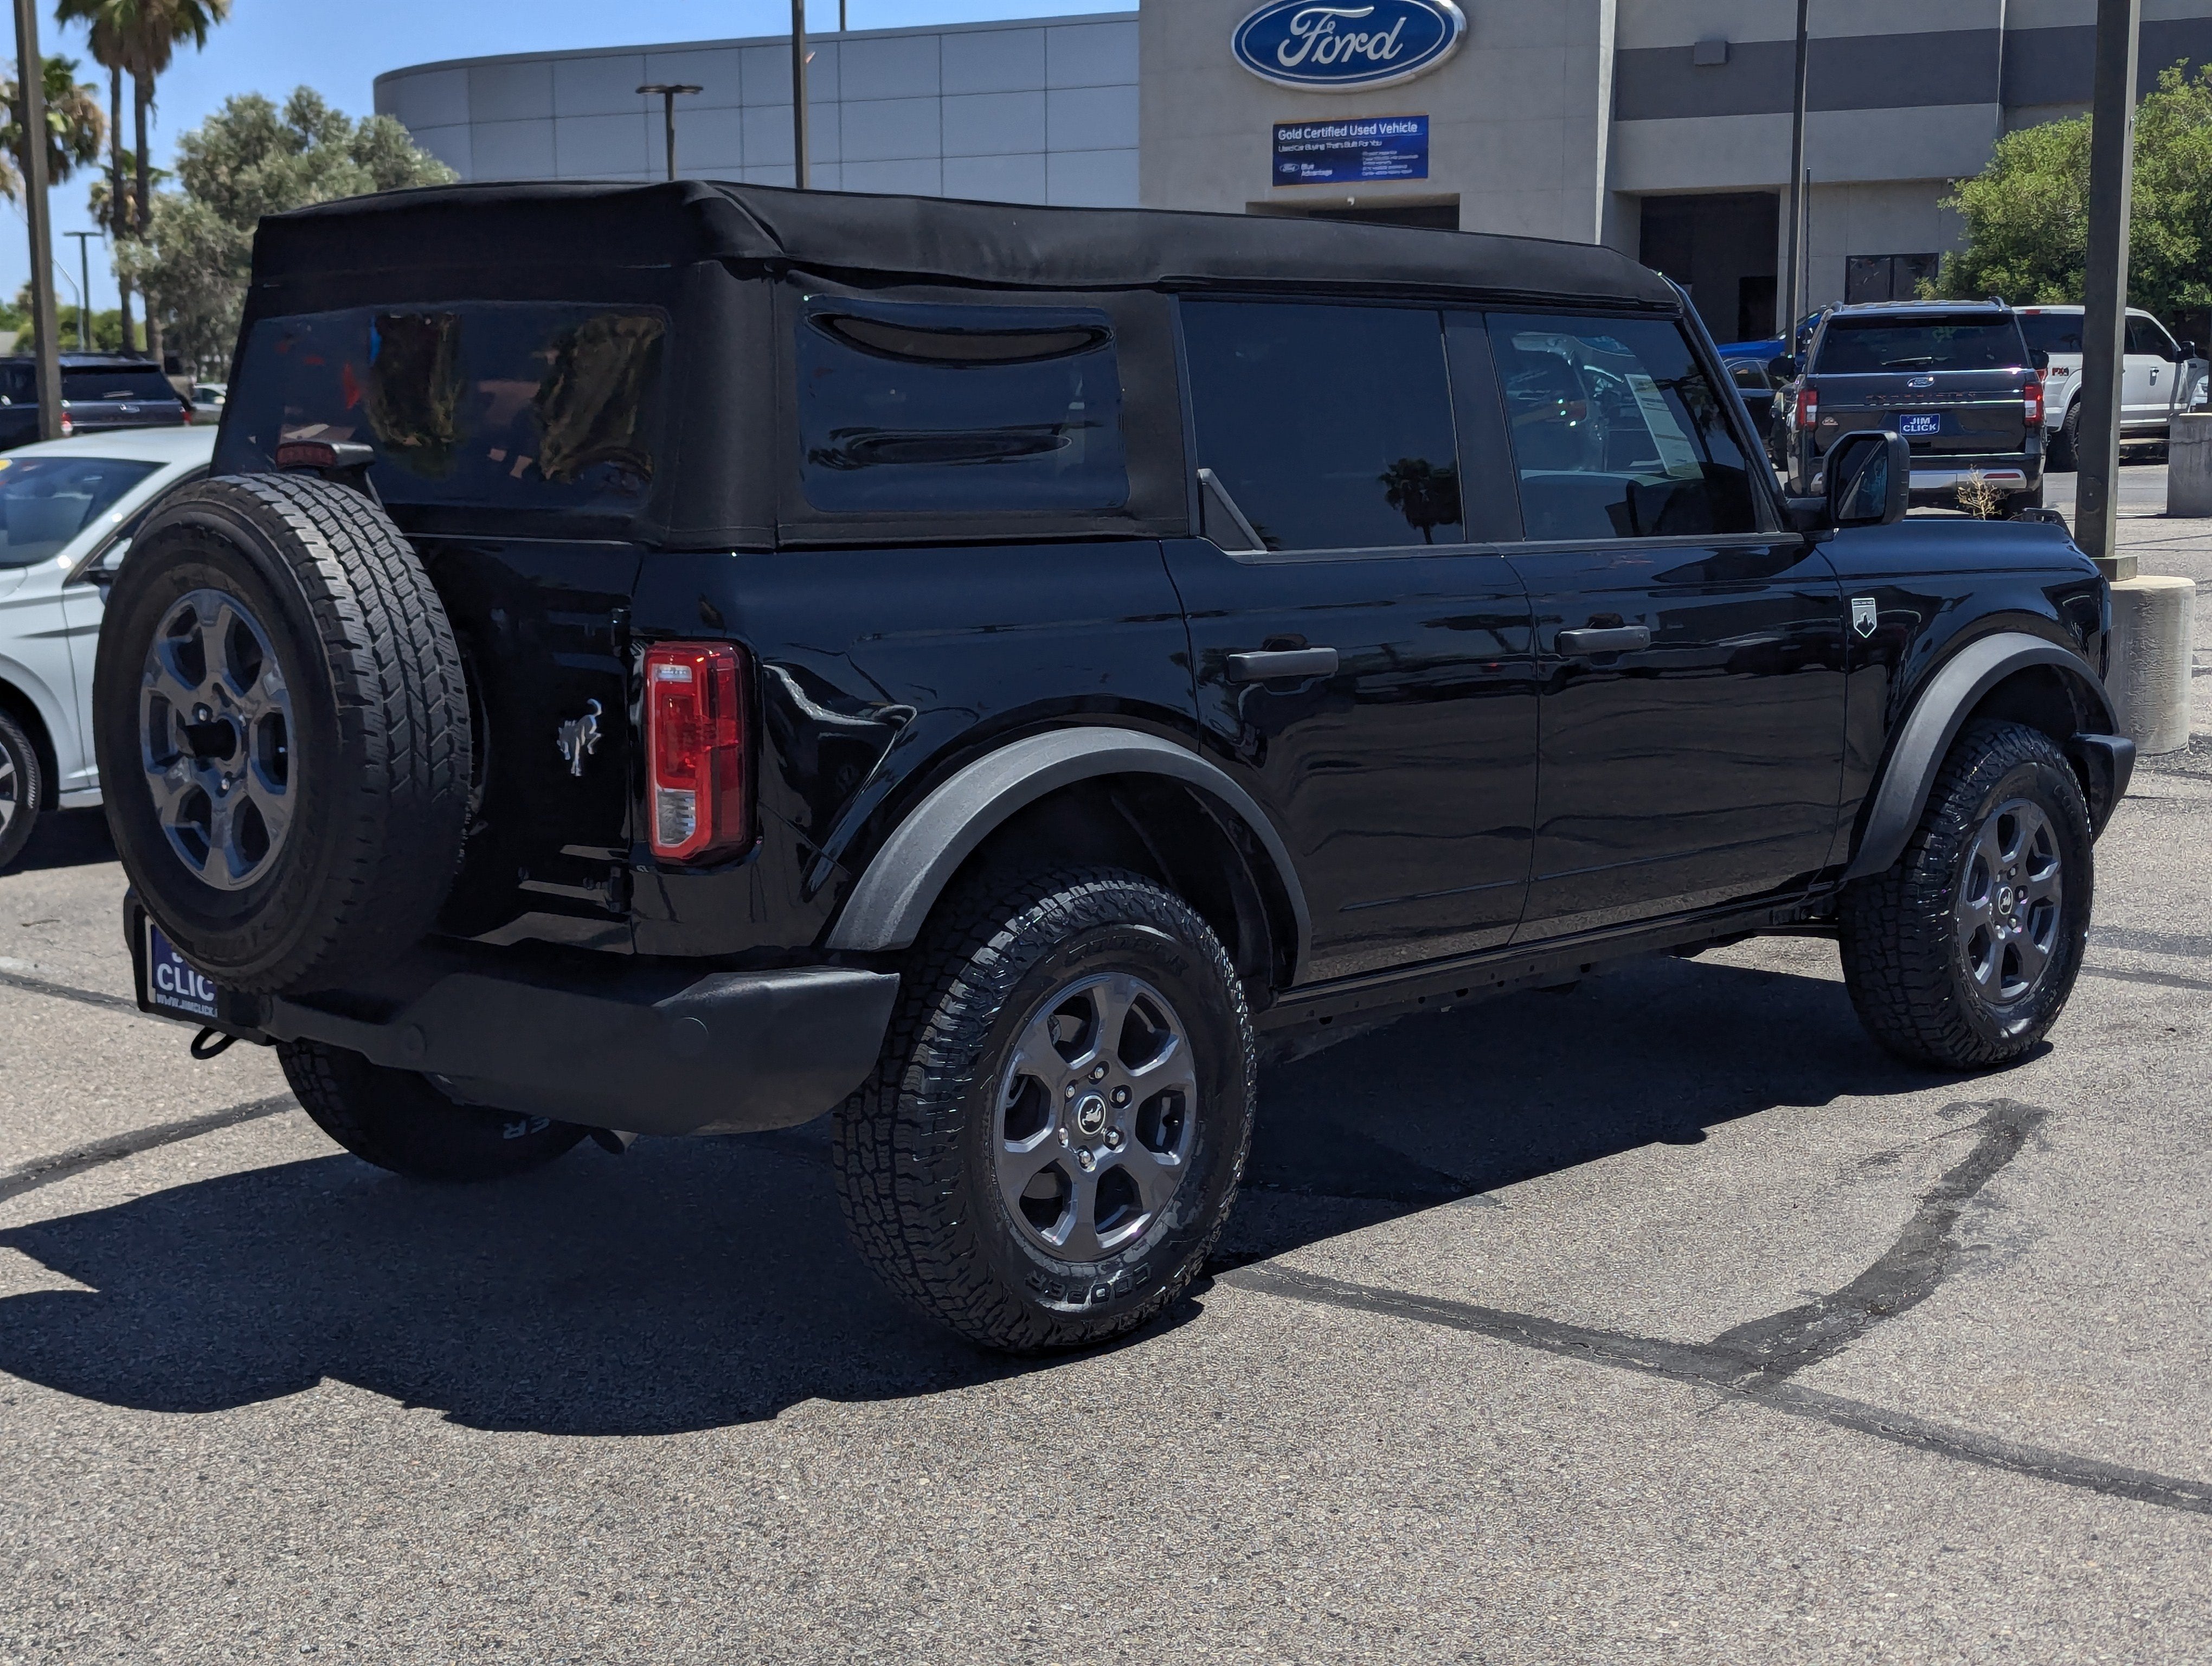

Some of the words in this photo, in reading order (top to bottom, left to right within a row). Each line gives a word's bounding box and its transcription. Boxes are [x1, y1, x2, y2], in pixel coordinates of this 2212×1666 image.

[1277, 7, 1407, 67] Ford
[1278, 128, 1302, 140] Gold
[1304, 124, 1347, 139] Certified
[1349, 123, 1377, 136] Used
[1379, 121, 1418, 134] Vehicle
[1903, 424, 1937, 432] CLICK
[157, 963, 215, 1001] CLIC
[1024, 1262, 1152, 1305] COOPER
